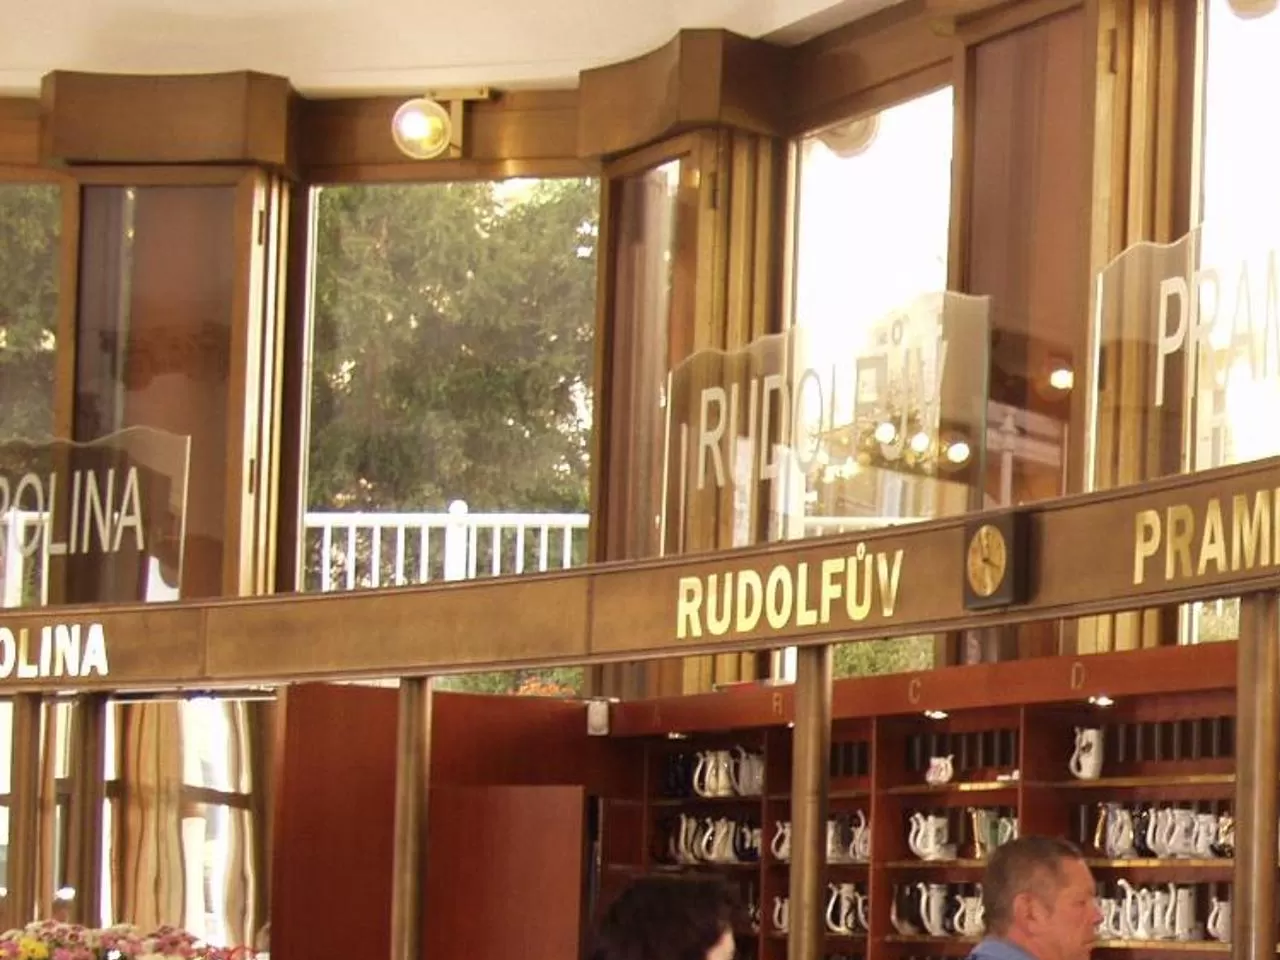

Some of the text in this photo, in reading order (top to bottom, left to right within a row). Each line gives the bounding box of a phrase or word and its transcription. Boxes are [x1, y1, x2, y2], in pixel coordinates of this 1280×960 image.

[677, 542, 904, 639] RUDOLFŮV
[1070, 661, 1086, 690] D
[908, 677, 922, 704] C
